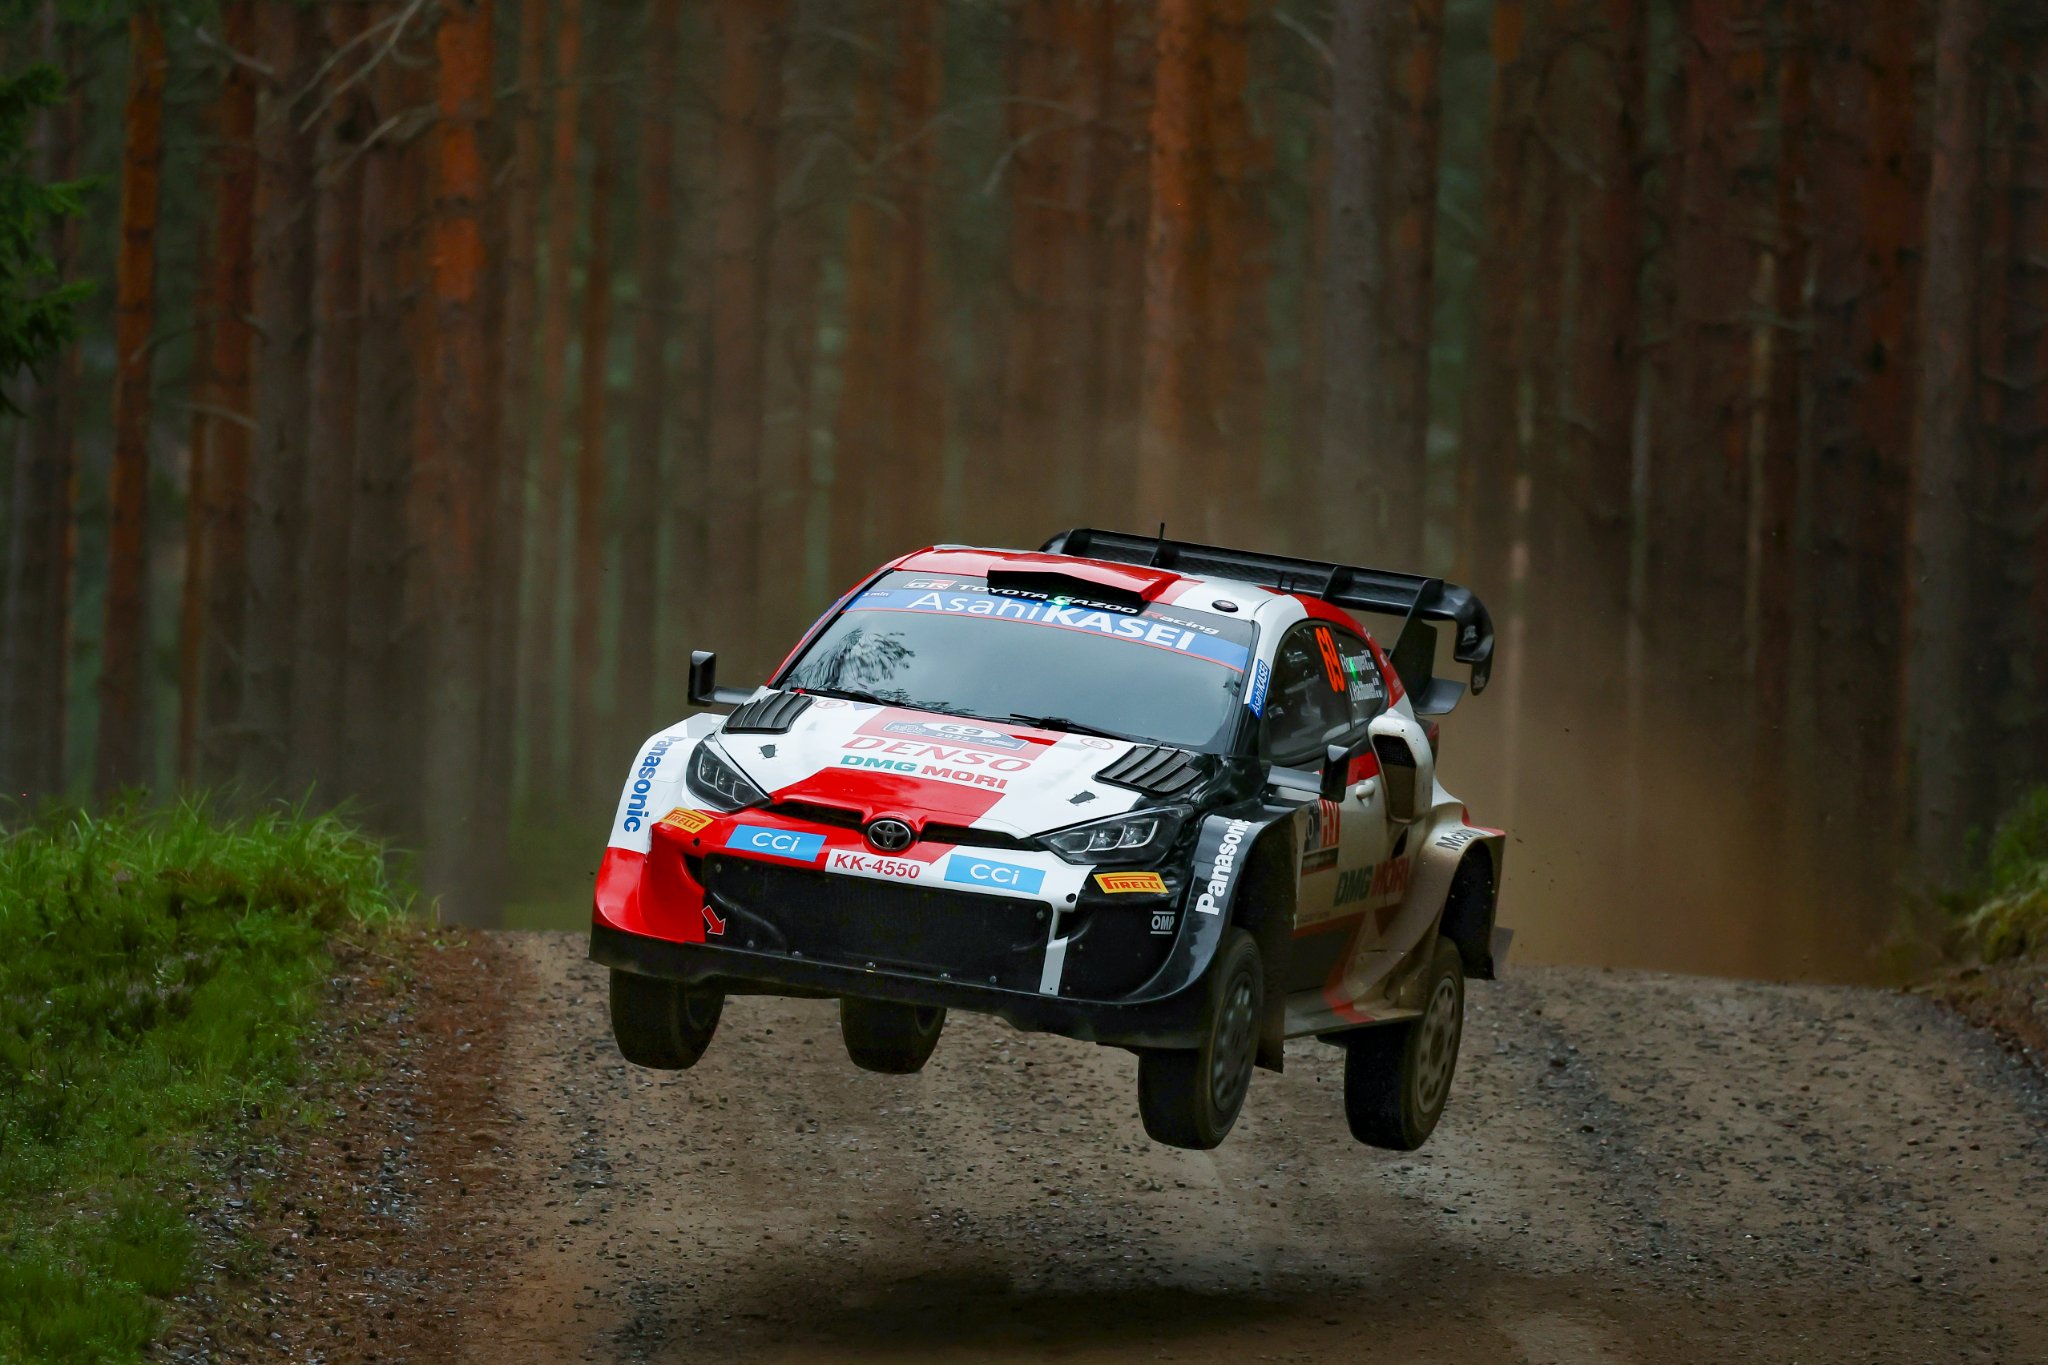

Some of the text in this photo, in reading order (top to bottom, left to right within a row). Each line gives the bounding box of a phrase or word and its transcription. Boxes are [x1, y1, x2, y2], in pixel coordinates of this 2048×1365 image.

[906, 580, 1220, 635] GR TOYOTA GAZOO Racing
[906, 592, 1196, 651] AsahiKASEI
[1315, 626, 1345, 693] 69
[940, 725, 984, 736] 69
[841, 737, 1032, 772] DENSO
[623, 735, 687, 833] Panasonic
[840, 755, 1008, 790] DMG MORI
[663, 810, 707, 830] PIRELLI
[834, 853, 921, 879] KK-4550
[1101, 875, 1162, 890] PIRELLI
[1195, 818, 1251, 916] Panasonic
[1151, 915, 1175, 931] OMP
